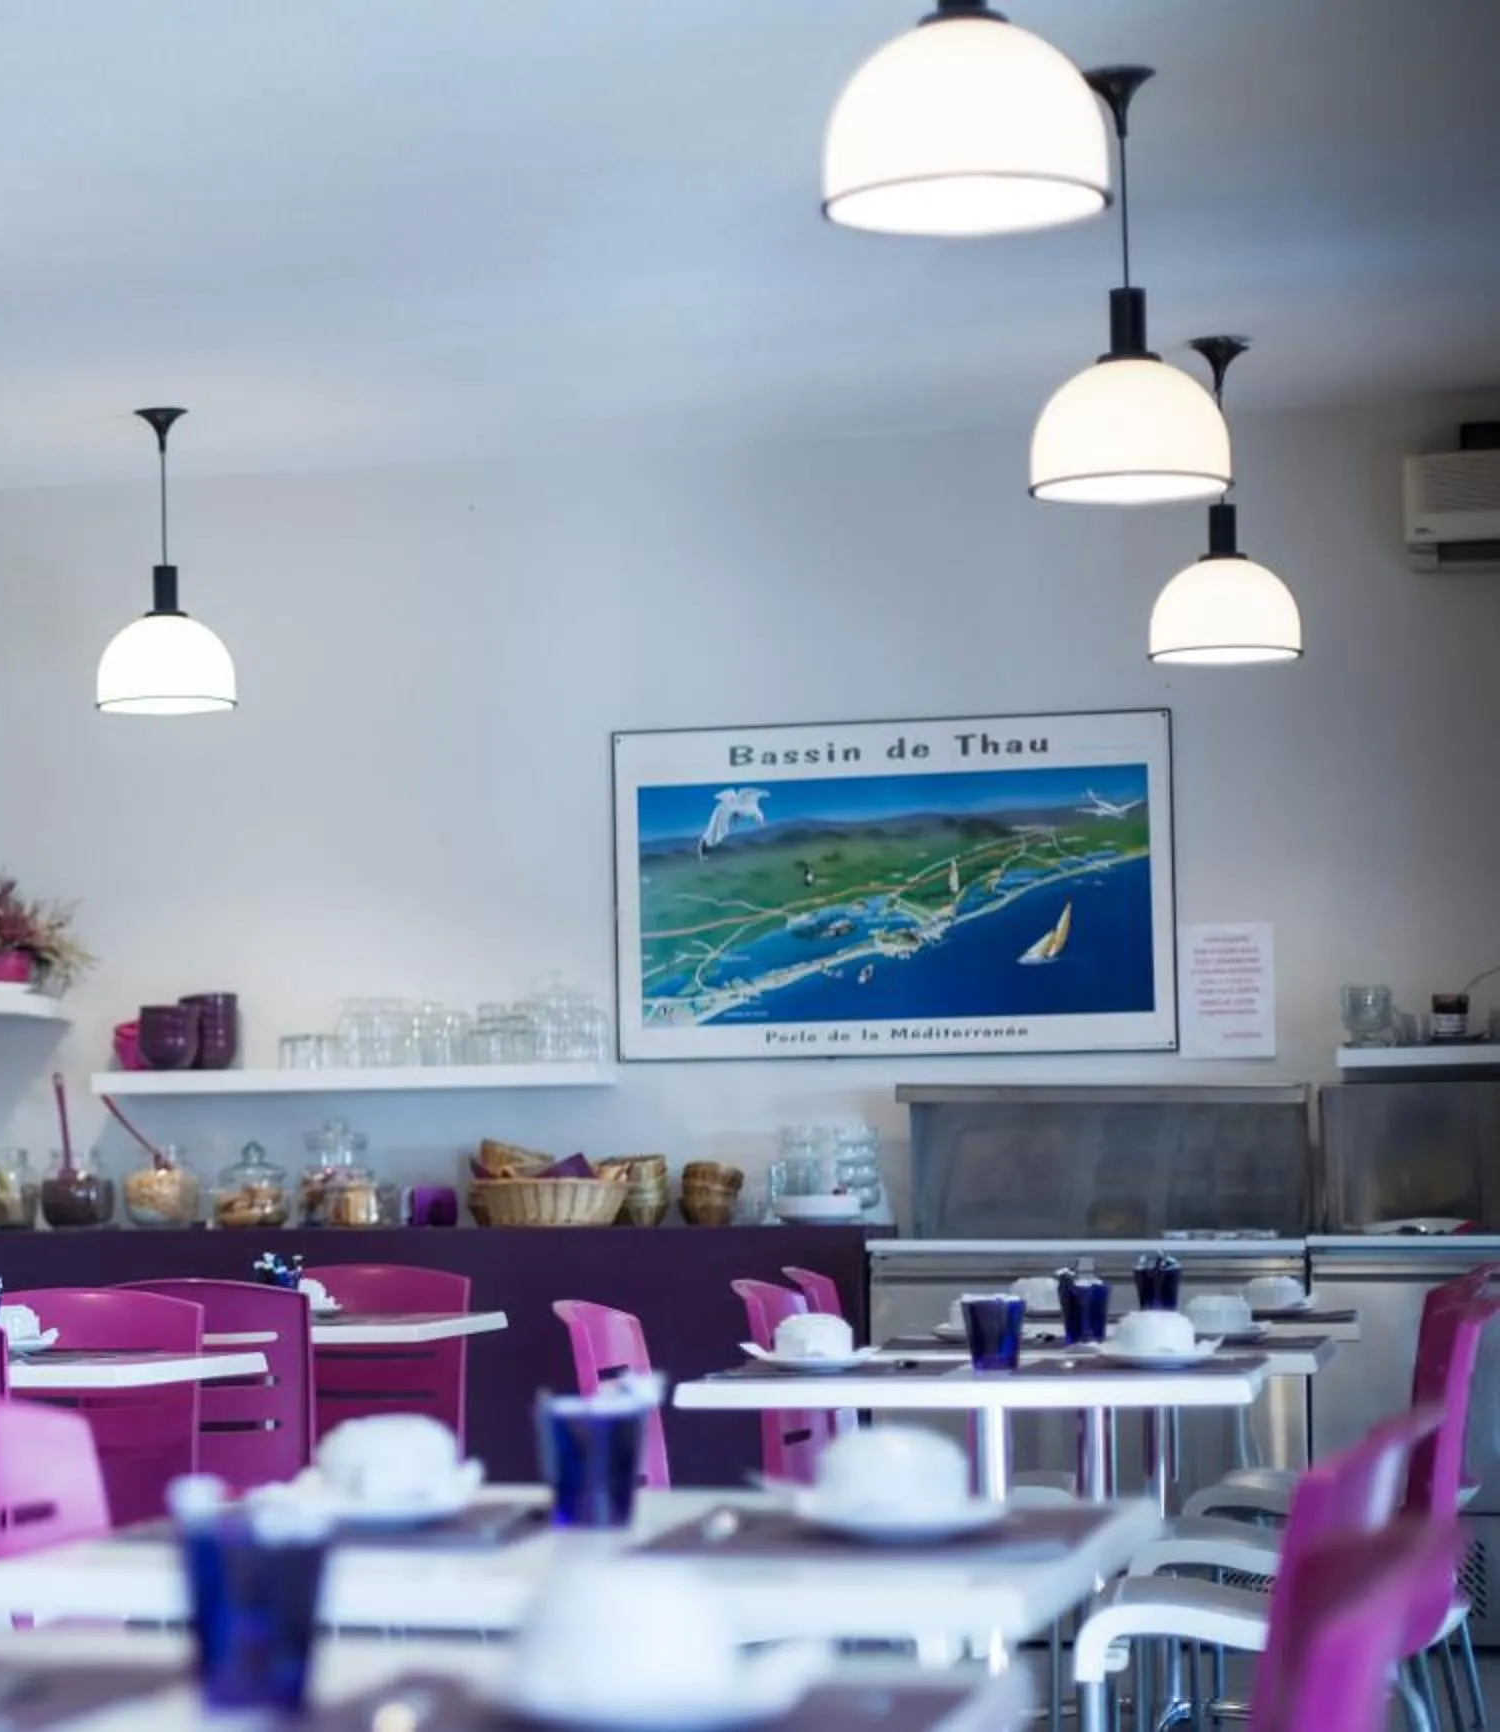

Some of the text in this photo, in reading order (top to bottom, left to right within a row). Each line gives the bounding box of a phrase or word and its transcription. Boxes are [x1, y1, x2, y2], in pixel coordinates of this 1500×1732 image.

[729, 732, 1049, 767] Bassin de Thau
[827, 1029, 850, 1042] de
